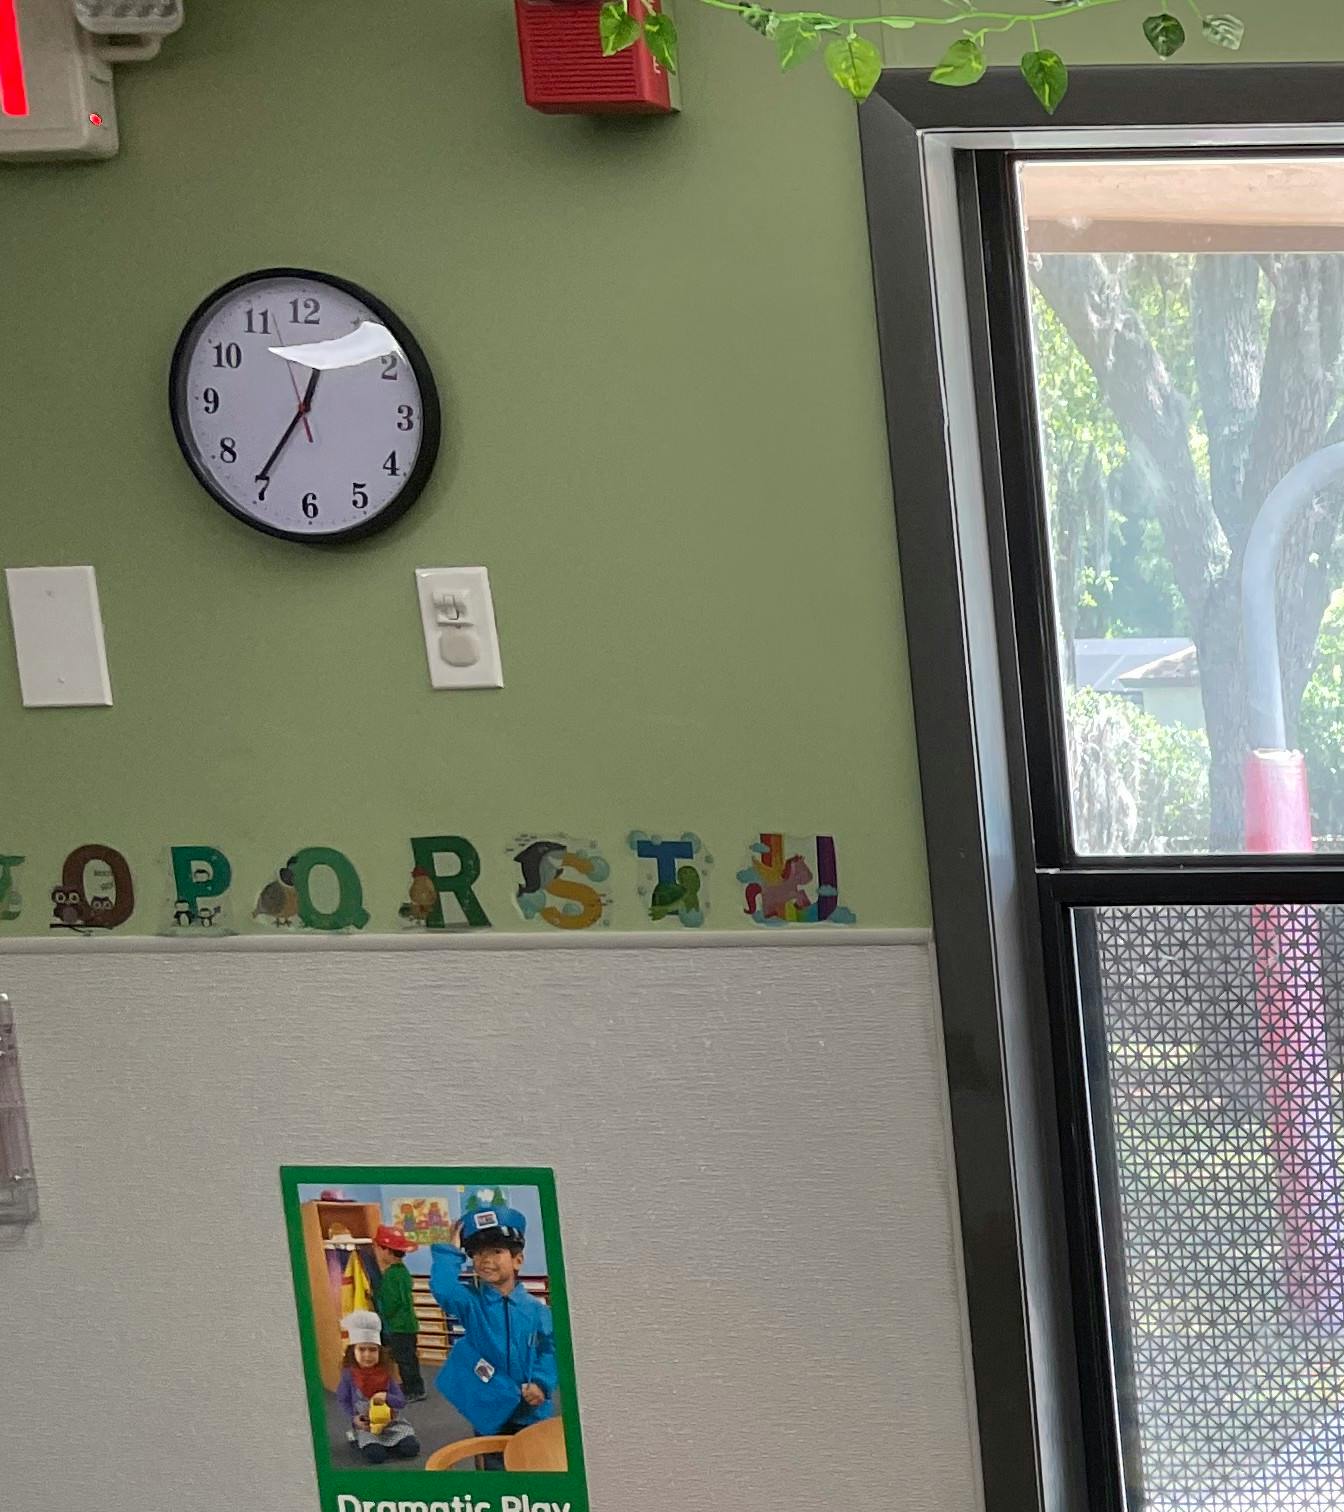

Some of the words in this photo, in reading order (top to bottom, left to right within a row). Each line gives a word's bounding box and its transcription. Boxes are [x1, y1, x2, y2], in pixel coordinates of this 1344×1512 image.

[243, 306, 272, 335] 11
[288, 297, 321, 325] 12
[212, 341, 242, 369] 10
[380, 354, 398, 381] 2
[202, 387, 219, 414] 9
[396, 403, 415, 431] 3
[219, 436, 238, 463] 8
[382, 450, 401, 477] 4
[254, 474, 270, 501] 7
[351, 482, 369, 509] 5
[301, 492, 319, 518] 6
[62, 844, 135, 928] O
[170, 845, 232, 924] P
[293, 846, 371, 930] Q
[410, 835, 492, 928] R
[516, 841, 604, 930] S
[637, 840, 694, 916] T
[759, 833, 838, 922] U
